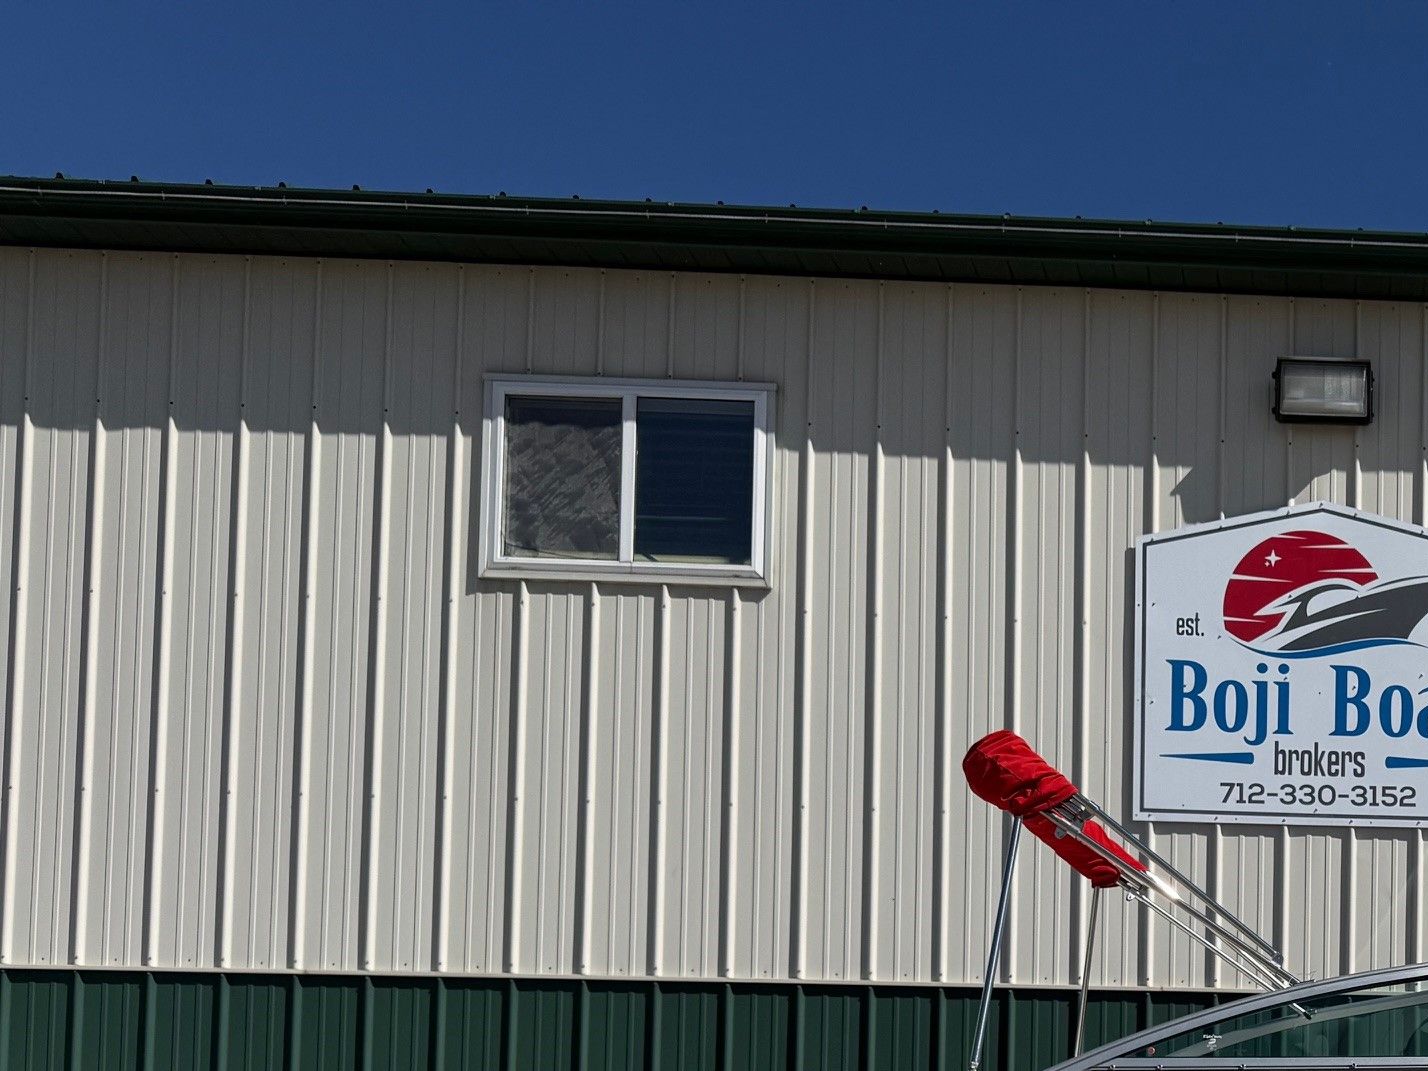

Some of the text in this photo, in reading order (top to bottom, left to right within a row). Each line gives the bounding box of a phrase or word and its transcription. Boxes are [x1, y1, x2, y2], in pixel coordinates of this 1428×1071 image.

[1176, 613, 1205, 637] est.
[1164, 658, 1295, 747] Boji
[1273, 740, 1366, 778] brokers
[1219, 781, 1417, 808] 712-330-3152
